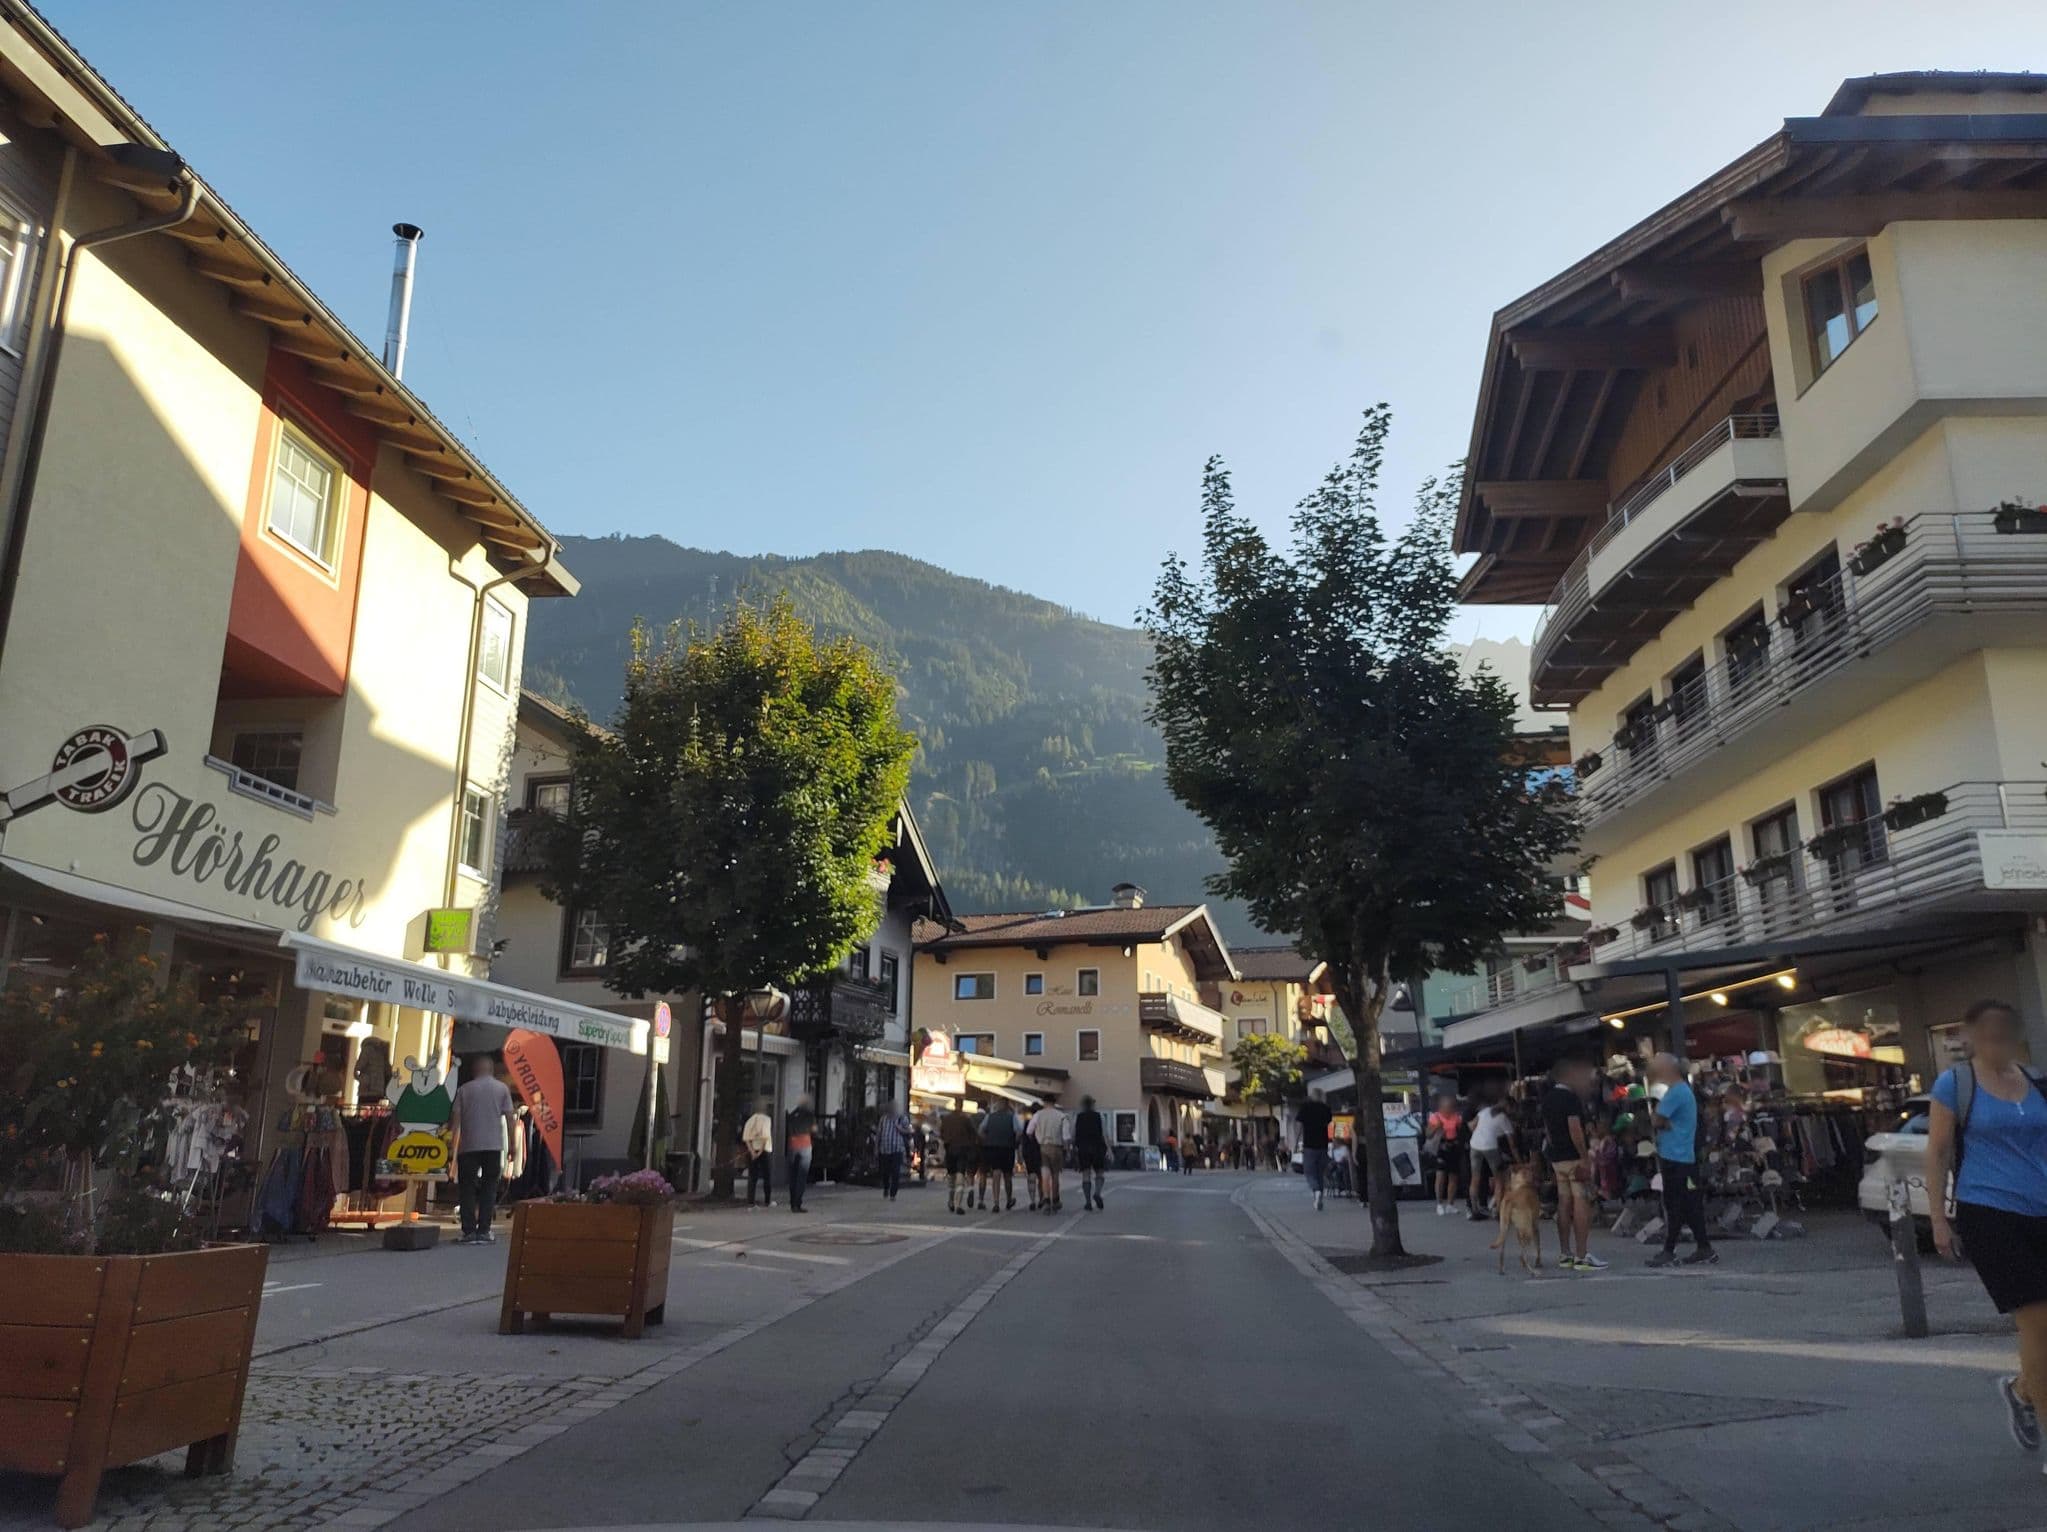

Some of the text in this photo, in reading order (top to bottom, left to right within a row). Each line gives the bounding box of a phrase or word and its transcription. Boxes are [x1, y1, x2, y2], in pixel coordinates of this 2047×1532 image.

[56, 732, 116, 766] TABAK
[68, 759, 126, 803] TRAFIK
[132, 782, 367, 932] Hörhager
[403, 978, 437, 1005] Wolle
[396, 1144, 442, 1160] LOTTO
